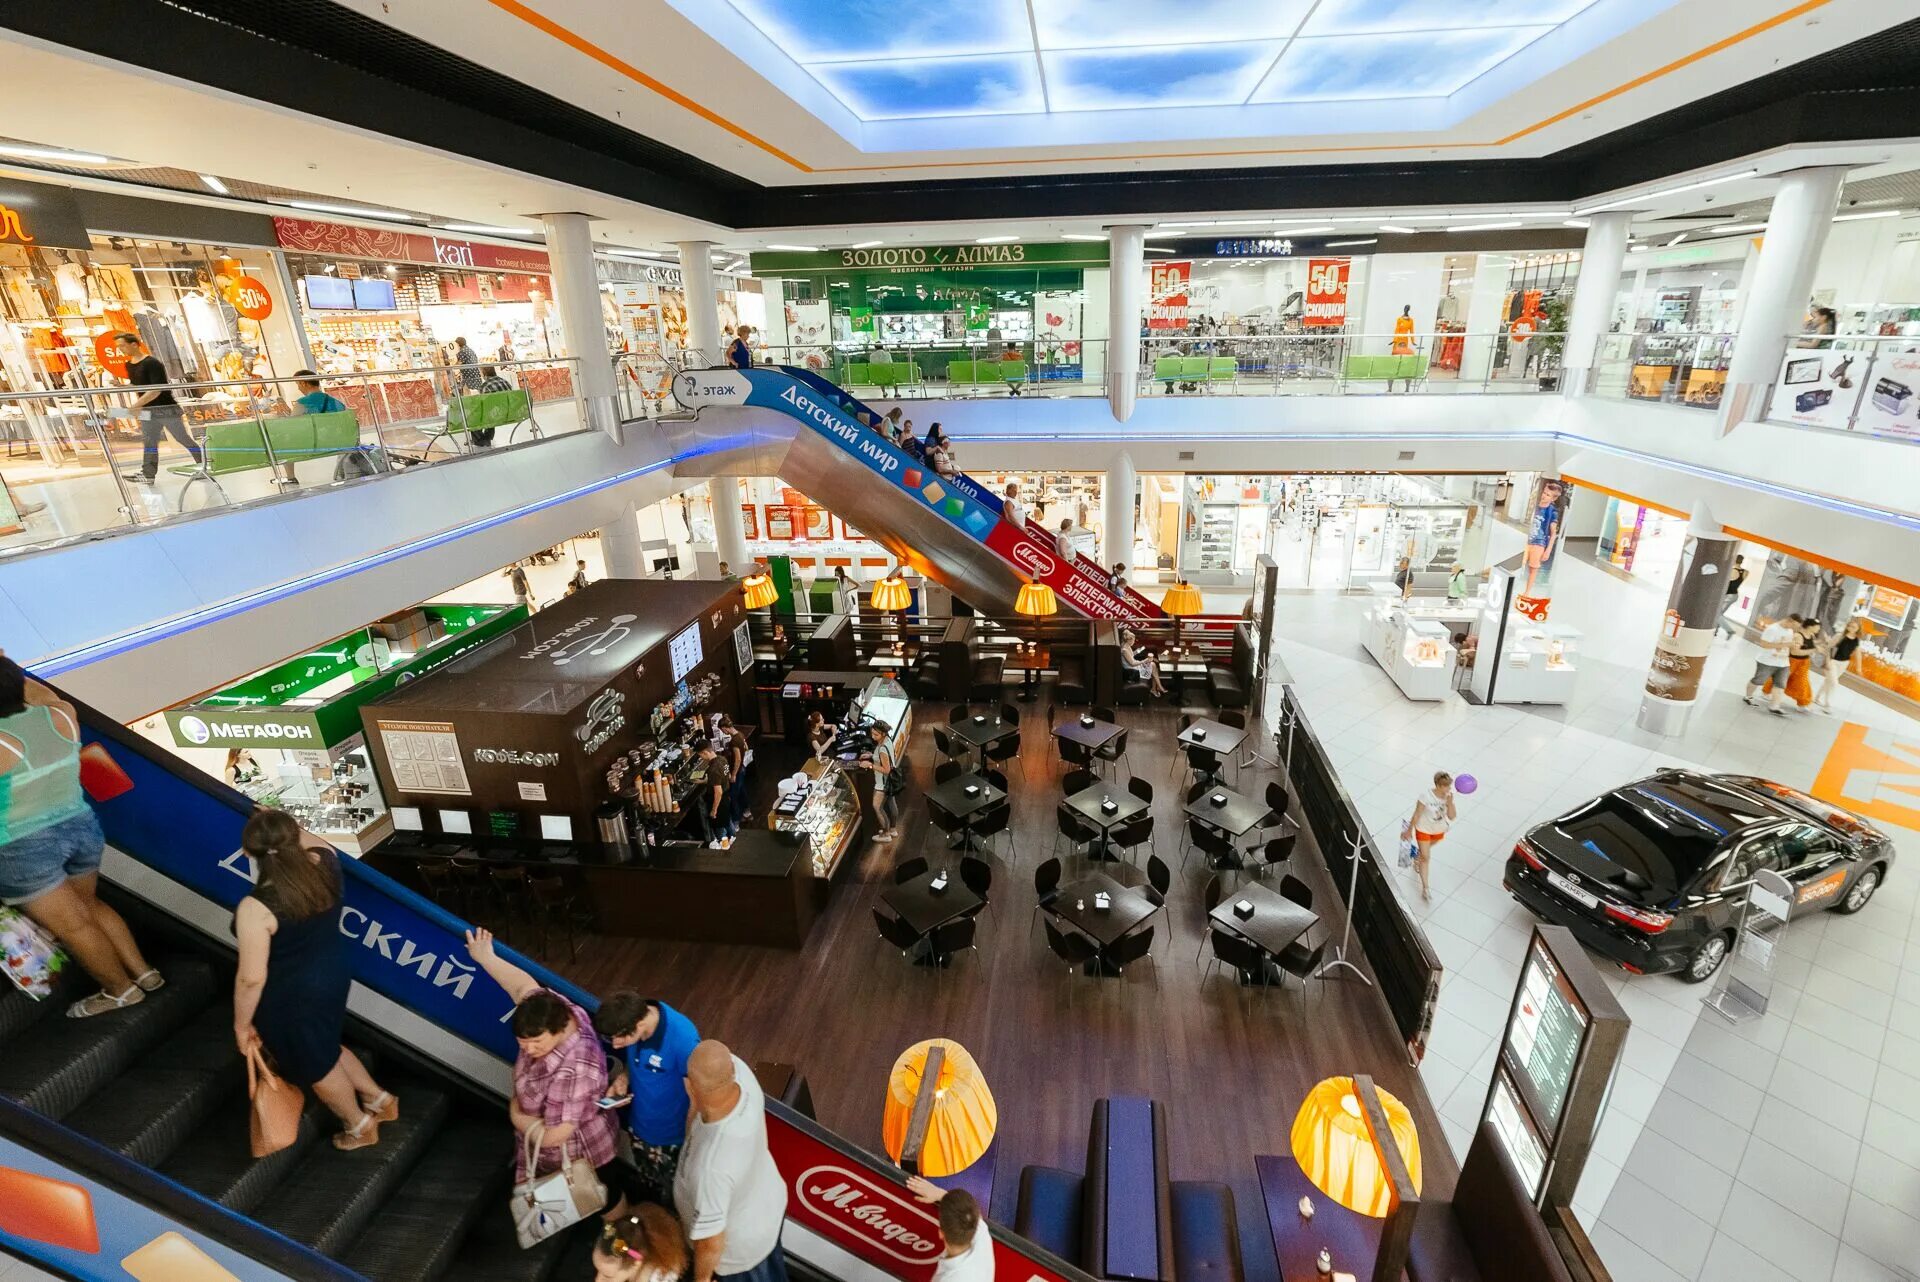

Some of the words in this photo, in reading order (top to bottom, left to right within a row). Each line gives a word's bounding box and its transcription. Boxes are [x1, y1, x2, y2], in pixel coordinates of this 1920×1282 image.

[433, 236, 474, 267] kari
[842, 248, 927, 267] ЗОЛОТО
[955, 244, 1025, 264] АЛМАЗ
[890, 266, 935, 274] ЮВЕЛИРНЫЙ
[941, 265, 975, 273] МАГАЗИН
[1151, 304, 1188, 321] СКИДКИ
[1305, 303, 1346, 320] СКИДКИ
[703, 382, 736, 396] этаж
[780, 384, 861, 445] Детский
[858, 439, 900, 473] мир
[1560, 880, 1586, 900] CAMRY
